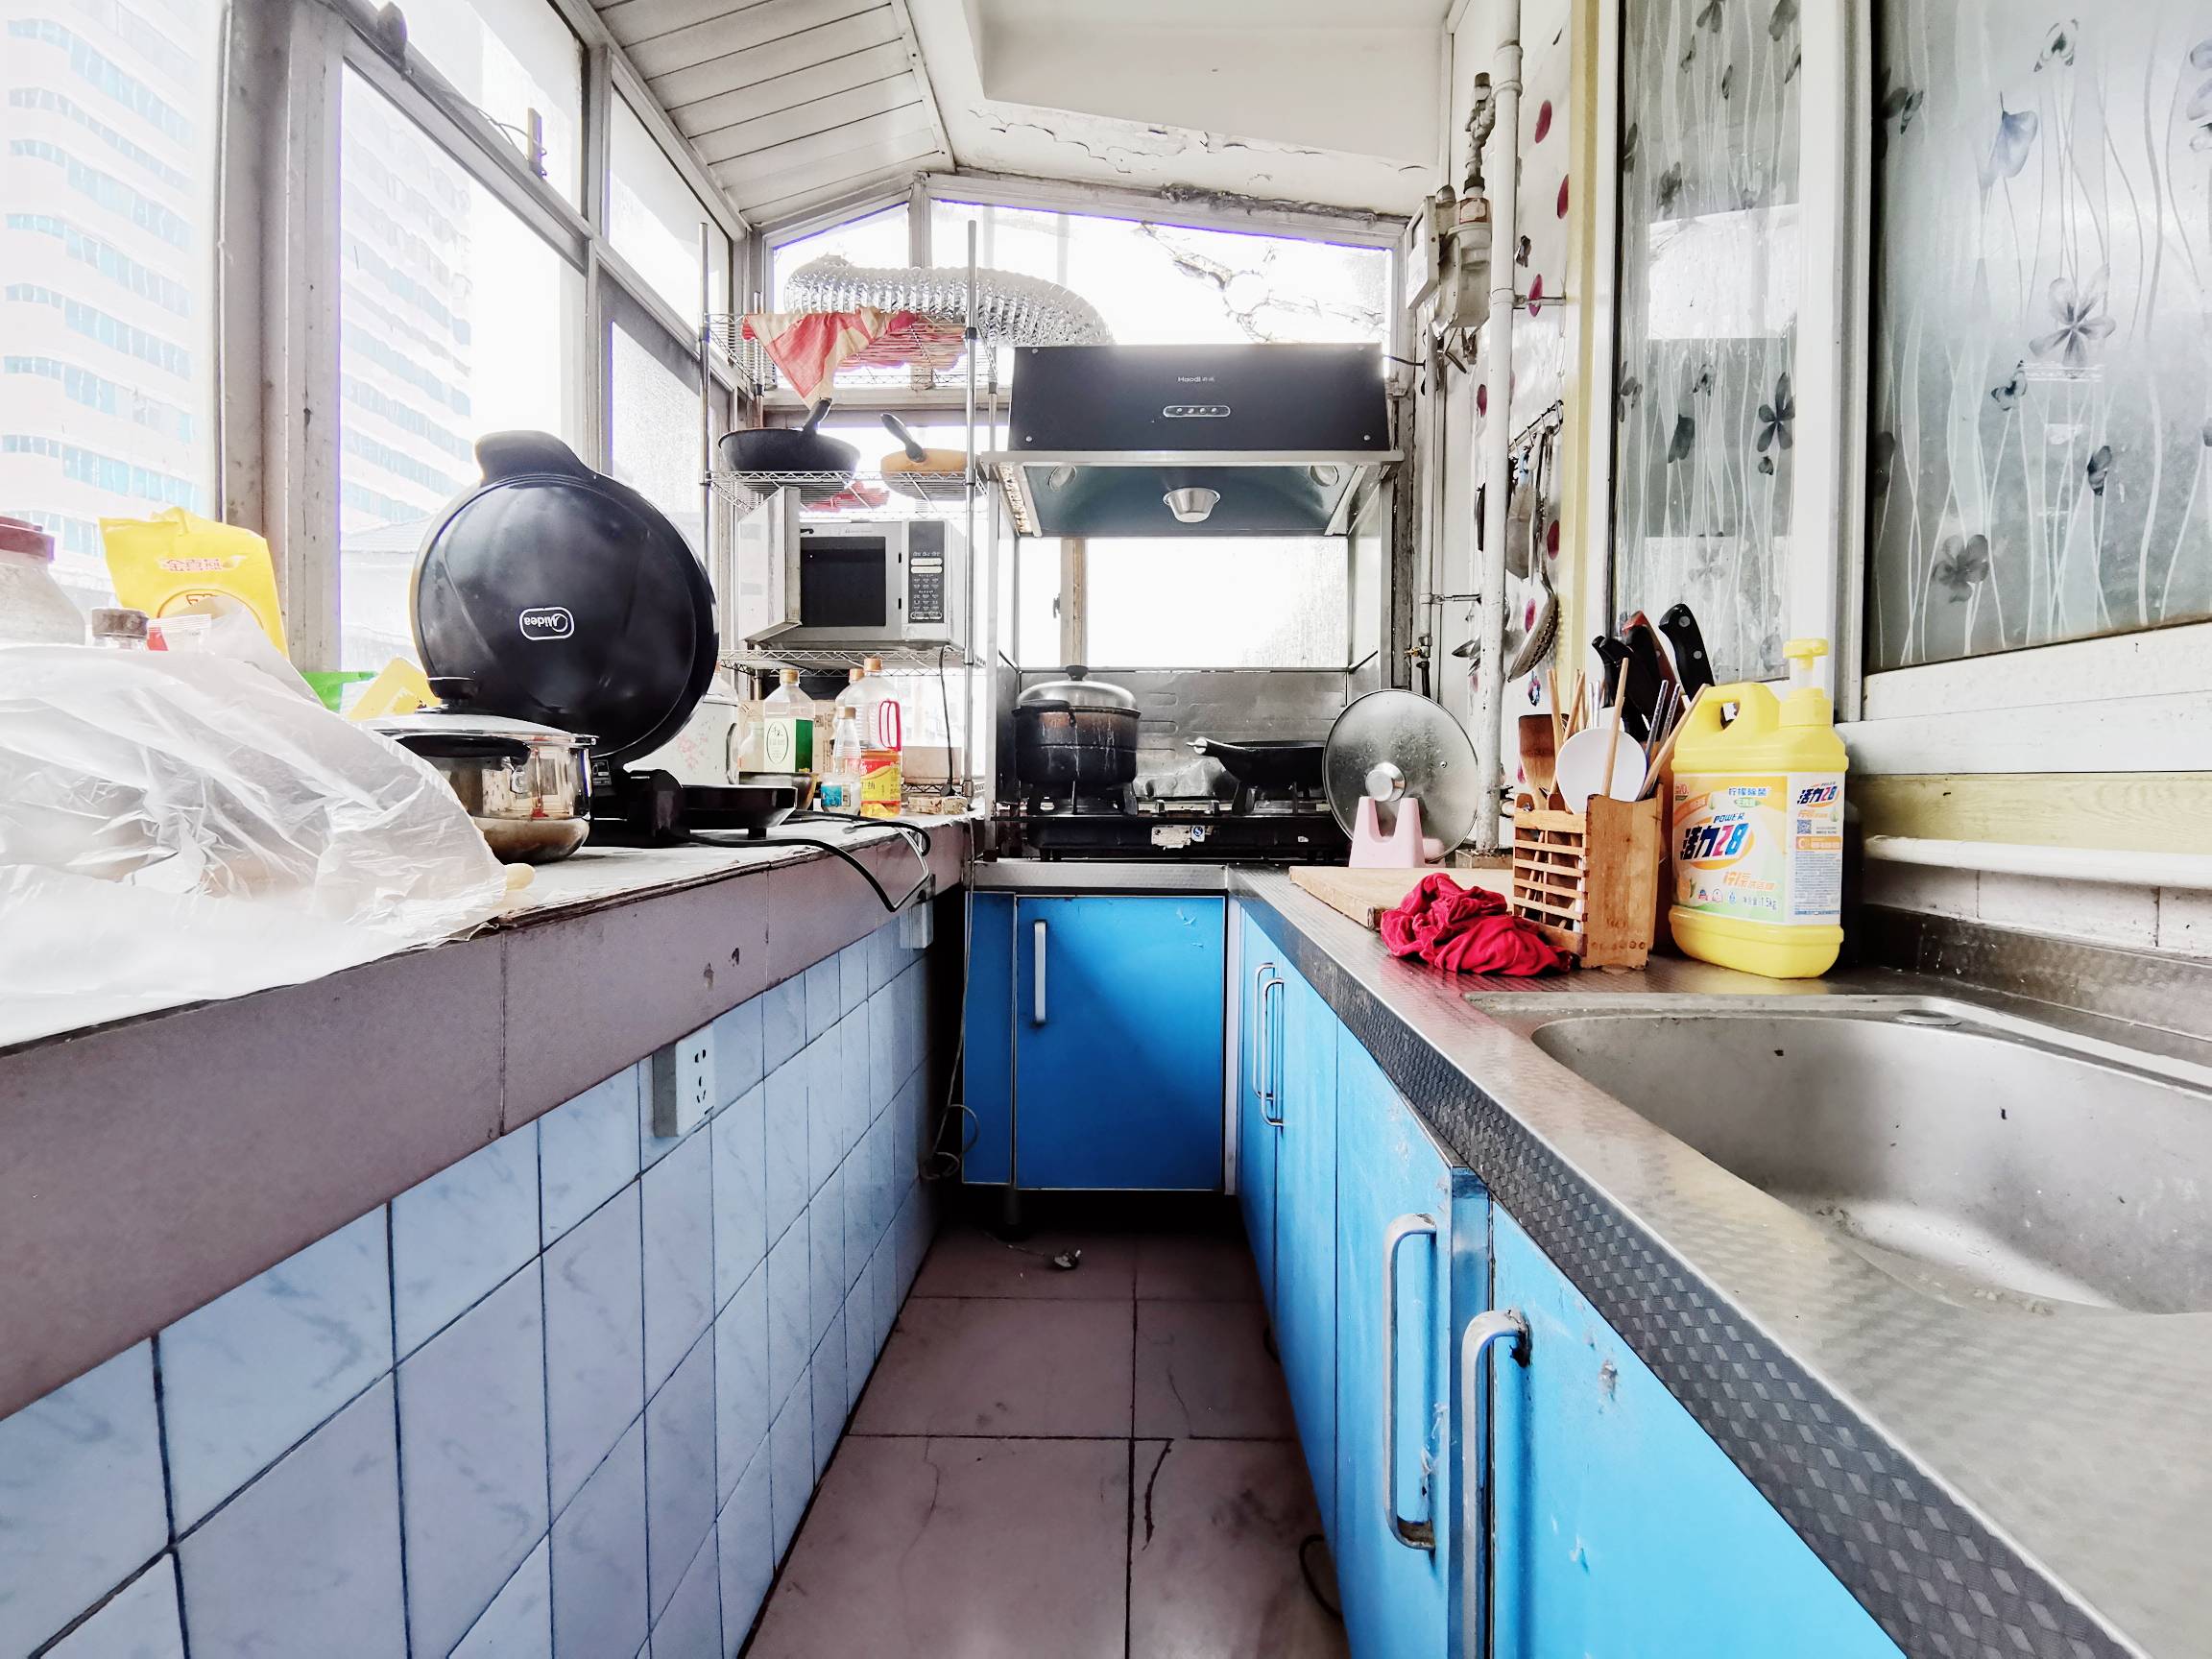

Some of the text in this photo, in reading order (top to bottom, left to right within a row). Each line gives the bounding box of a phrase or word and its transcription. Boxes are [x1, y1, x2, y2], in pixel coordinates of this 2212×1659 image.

[523, 613, 568, 633] Midea
[1797, 785, 1838, 805] 活力28
[1714, 812, 1745, 824] POWER
[1680, 823, 1749, 860] 活力28
